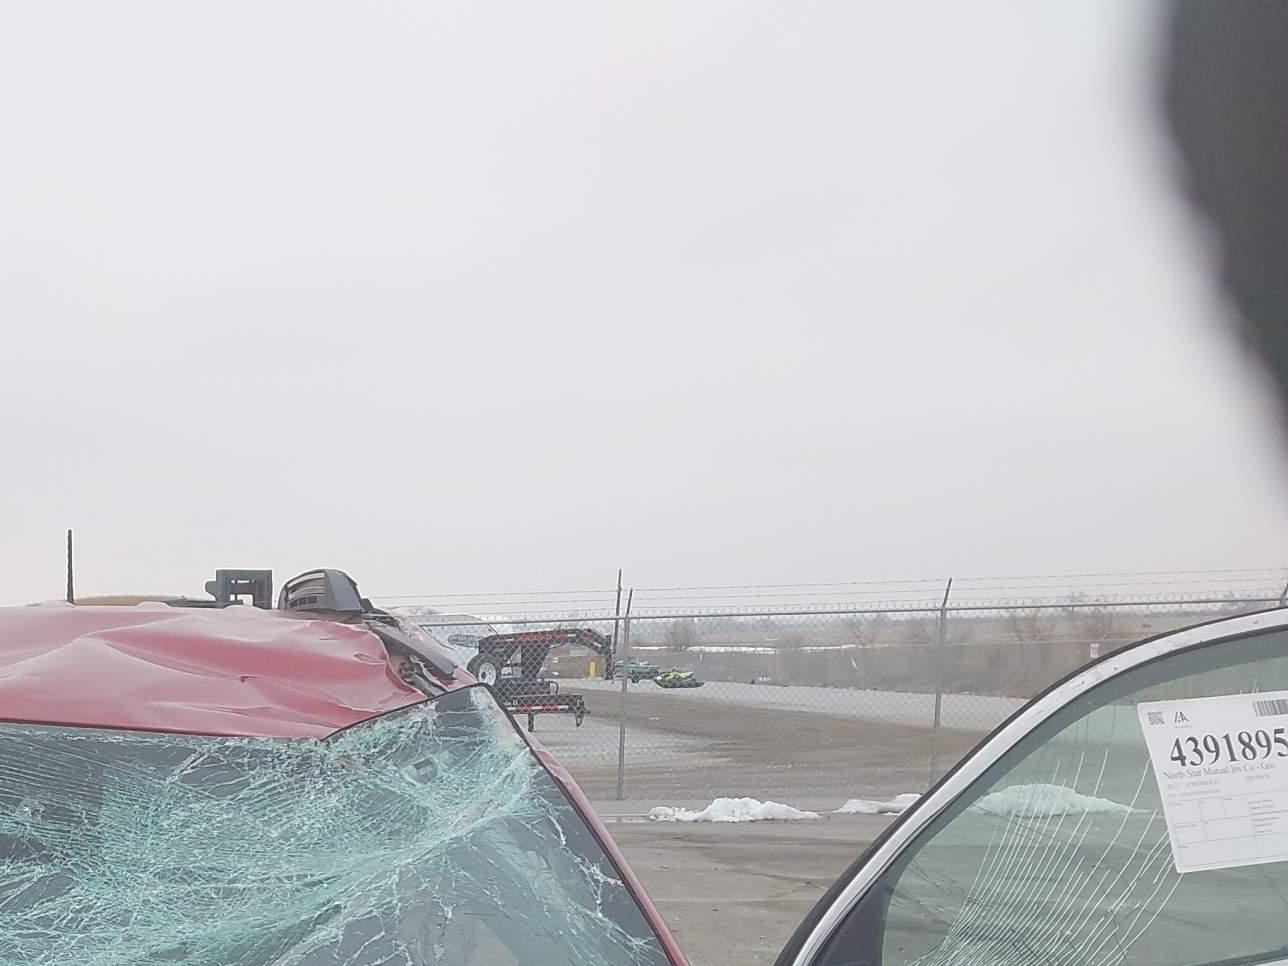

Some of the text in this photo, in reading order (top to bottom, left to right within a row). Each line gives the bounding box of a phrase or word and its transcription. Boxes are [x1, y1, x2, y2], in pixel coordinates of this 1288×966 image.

[1162, 769, 1186, 780] North
[1186, 769, 1202, 777] Star
[1203, 765, 1229, 775] Mutual
